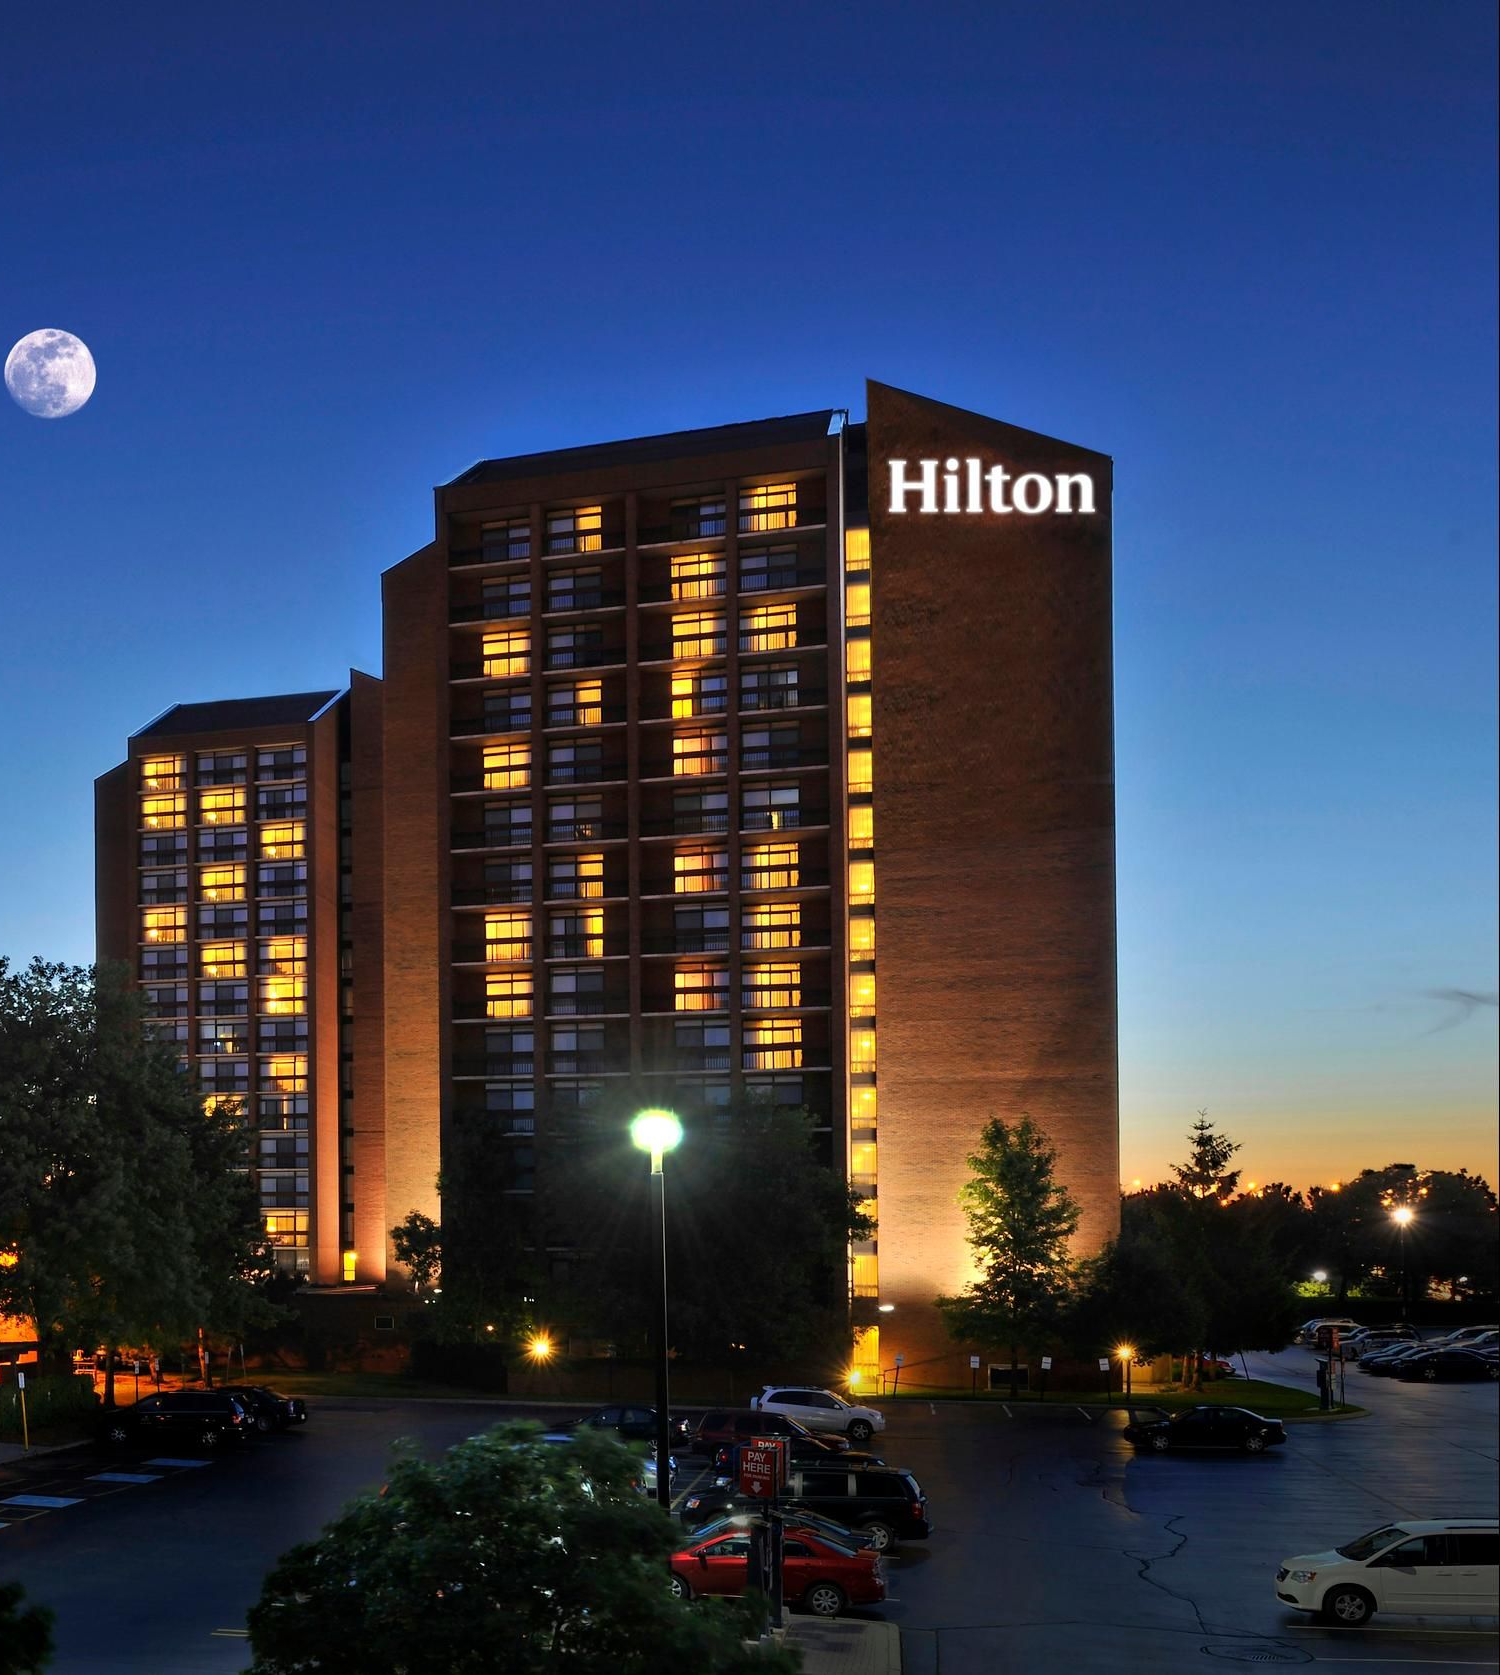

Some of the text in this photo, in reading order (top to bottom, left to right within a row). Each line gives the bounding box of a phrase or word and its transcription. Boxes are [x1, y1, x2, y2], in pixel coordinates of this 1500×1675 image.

[888, 458, 1096, 514] Hilton
[747, 1451, 766, 1462] PAY
[742, 1461, 771, 1474] HERE
